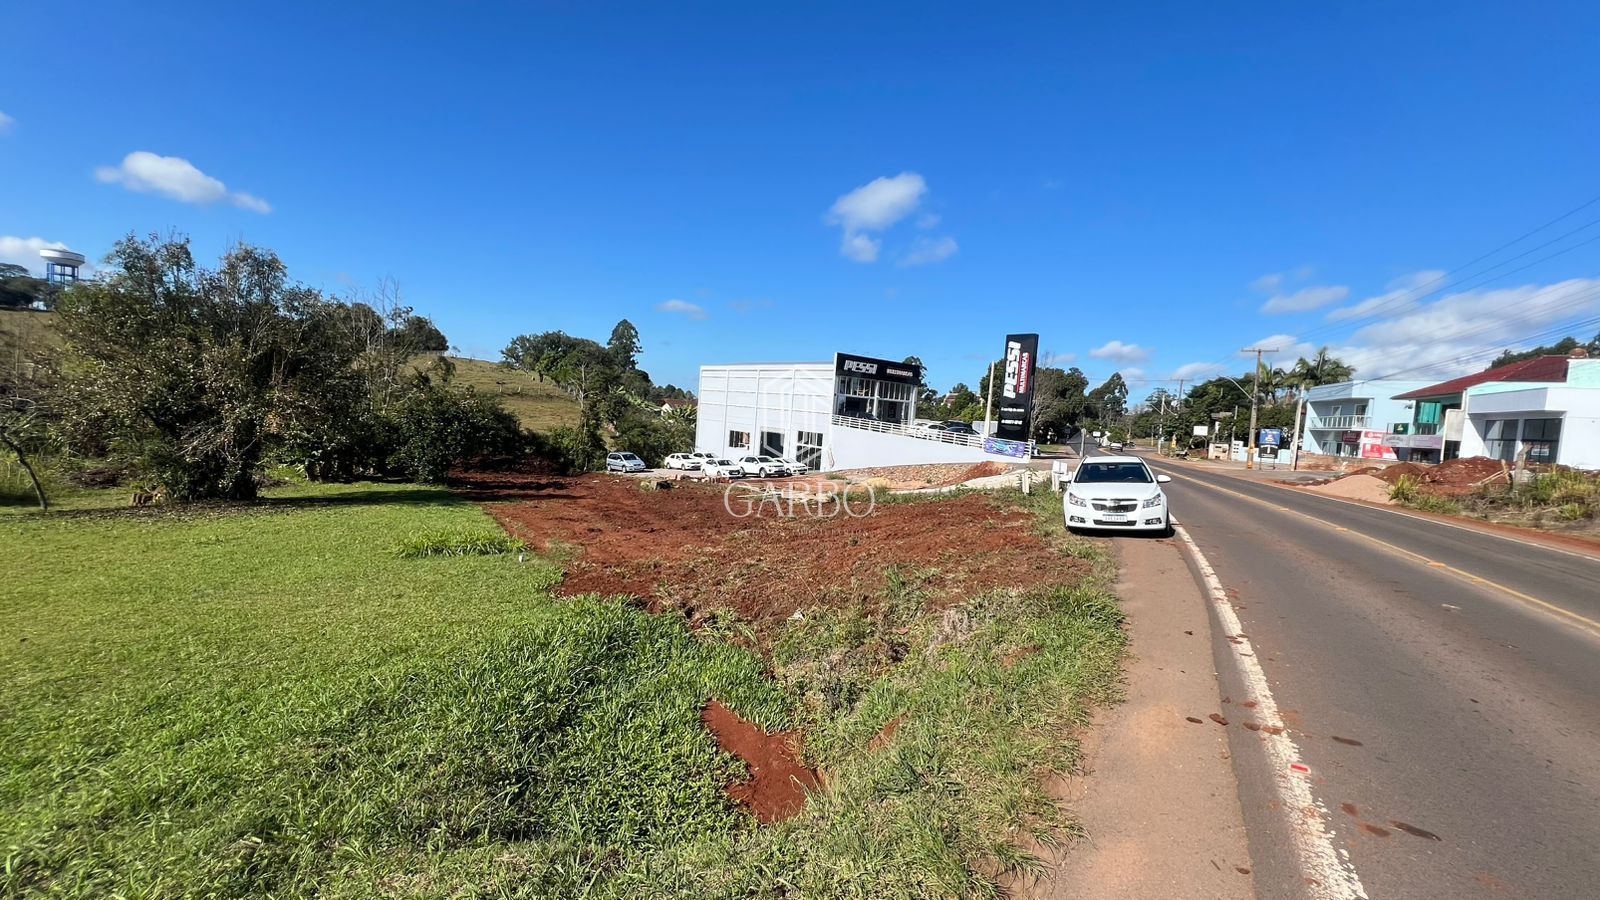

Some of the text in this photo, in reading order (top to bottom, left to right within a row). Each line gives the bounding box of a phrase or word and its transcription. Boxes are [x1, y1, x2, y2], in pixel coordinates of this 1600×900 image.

[843, 360, 878, 375] PESSI
[1003, 341, 1021, 398] PESSI
[1019, 352, 1029, 393] MULTIMARCAS
